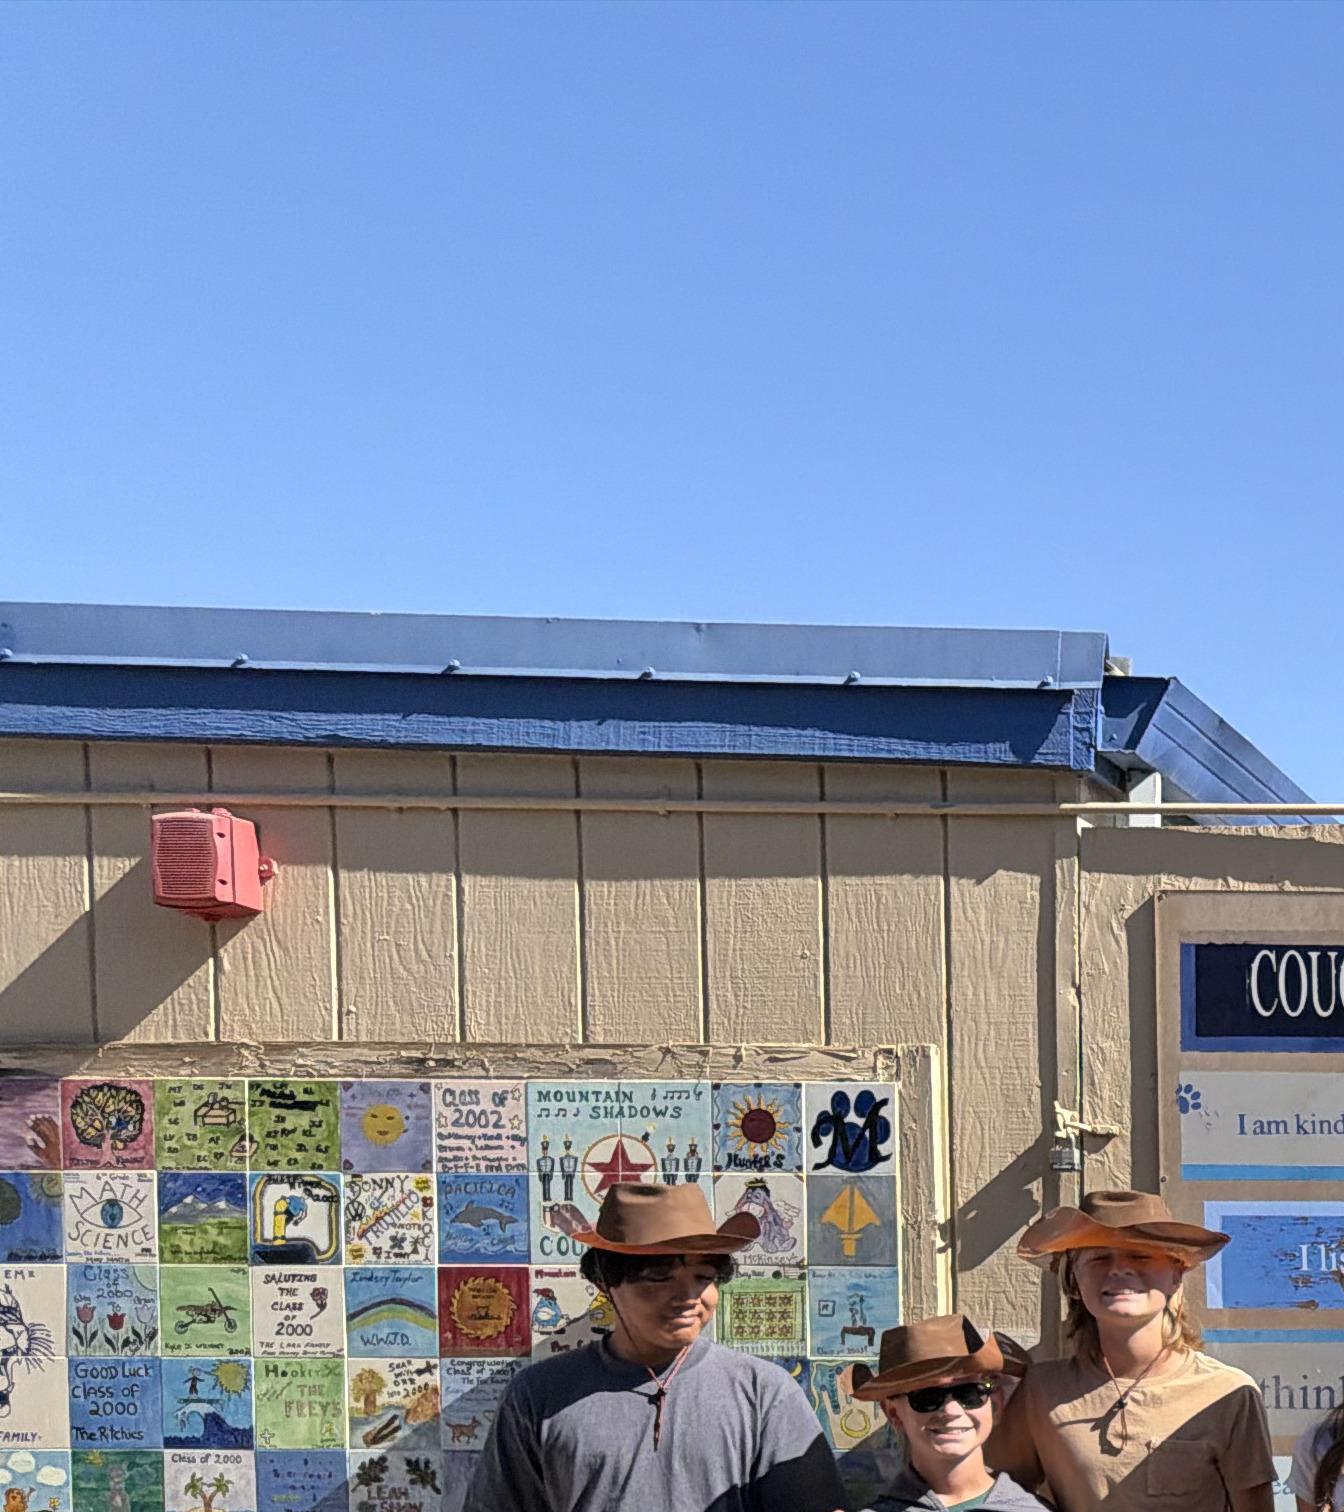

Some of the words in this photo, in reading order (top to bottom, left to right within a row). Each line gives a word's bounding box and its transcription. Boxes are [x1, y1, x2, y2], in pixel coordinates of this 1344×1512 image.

[537, 1089, 634, 1104] MOUNTAIN
[450, 1108, 506, 1129] 2002
[589, 1106, 683, 1119] SHADOWS
[1237, 1113, 1247, 1136] I
[1253, 1118, 1289, 1136] am
[69, 1180, 148, 1214] MATH
[68, 1220, 155, 1250] SCIENCE
[1299, 1244, 1311, 1271] I
[262, 1272, 317, 1285] SALUTING
[278, 1287, 300, 1297] THE
[271, 1302, 305, 1312] CLASS
[284, 1314, 298, 1322] OF
[275, 1323, 313, 1337] 2000
[89, 1401, 138, 1416] 2000
[72, 1426, 97, 1441] The
[171, 1453, 196, 1464] Class
[200, 1453, 211, 1464] of
[214, 1454, 242, 1465] 2000
